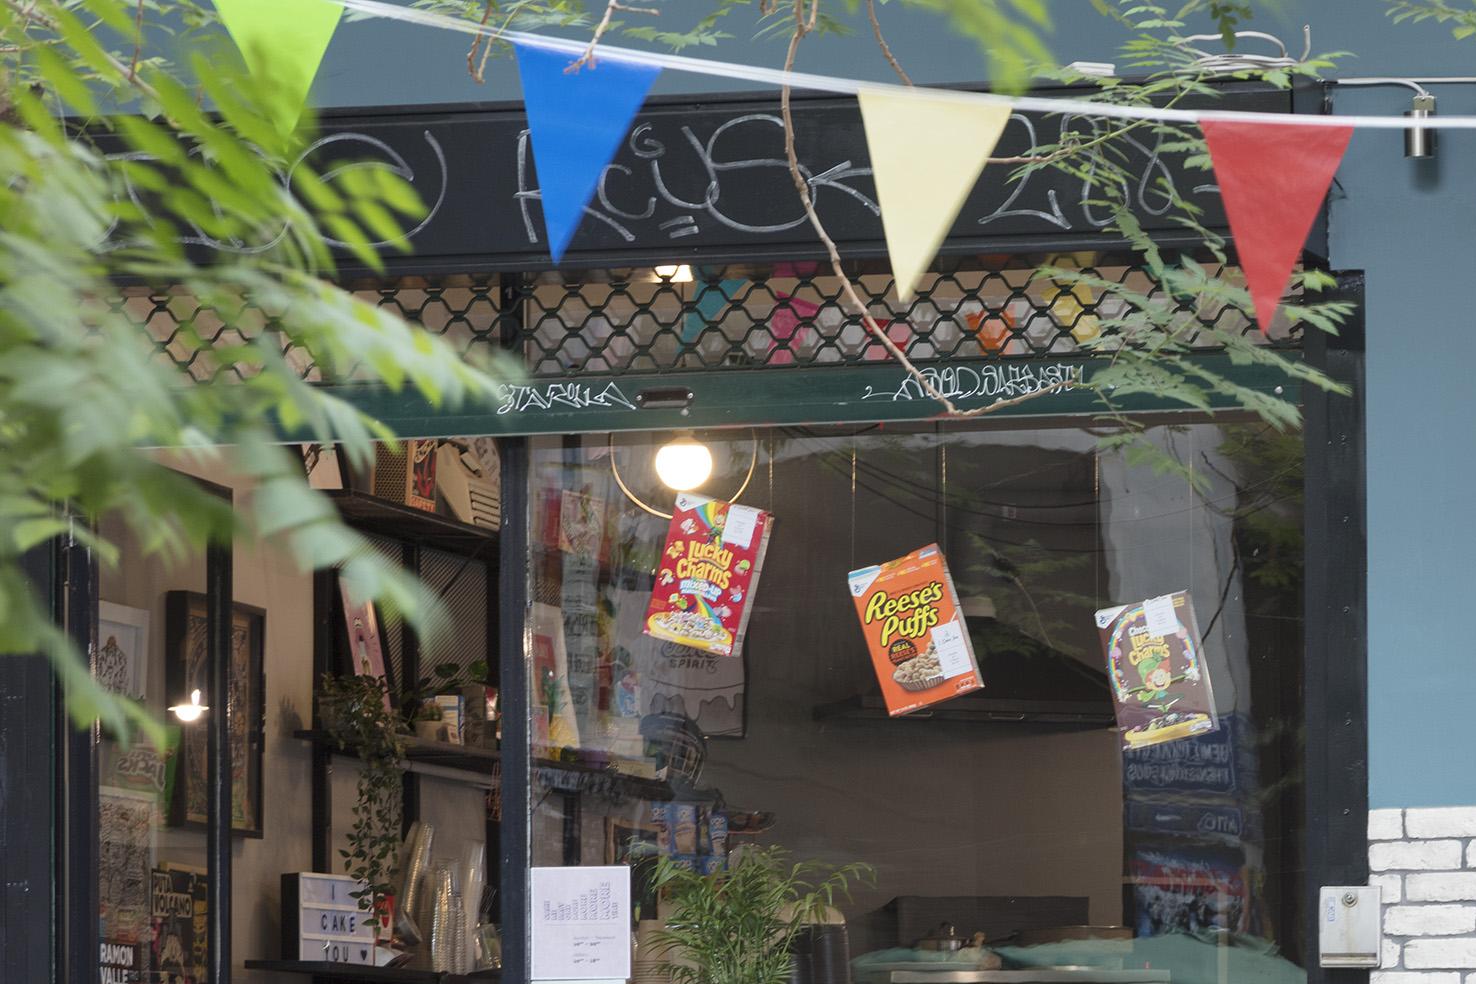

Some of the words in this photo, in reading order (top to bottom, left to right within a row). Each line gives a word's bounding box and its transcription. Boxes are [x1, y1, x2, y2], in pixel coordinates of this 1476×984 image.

[688, 540, 734, 571] Lucky
[676, 558, 733, 590] Charms
[864, 581, 944, 625] Reese's
[880, 605, 939, 648] Puffs
[1128, 624, 1150, 637] Choco
[891, 642, 911, 653] REAL
[590, 889, 598, 920] MORE
[601, 881, 611, 920] MORE
[321, 914, 356, 933] CAKE
[100, 944, 133, 967] RAMON
[325, 944, 349, 962] YOU
